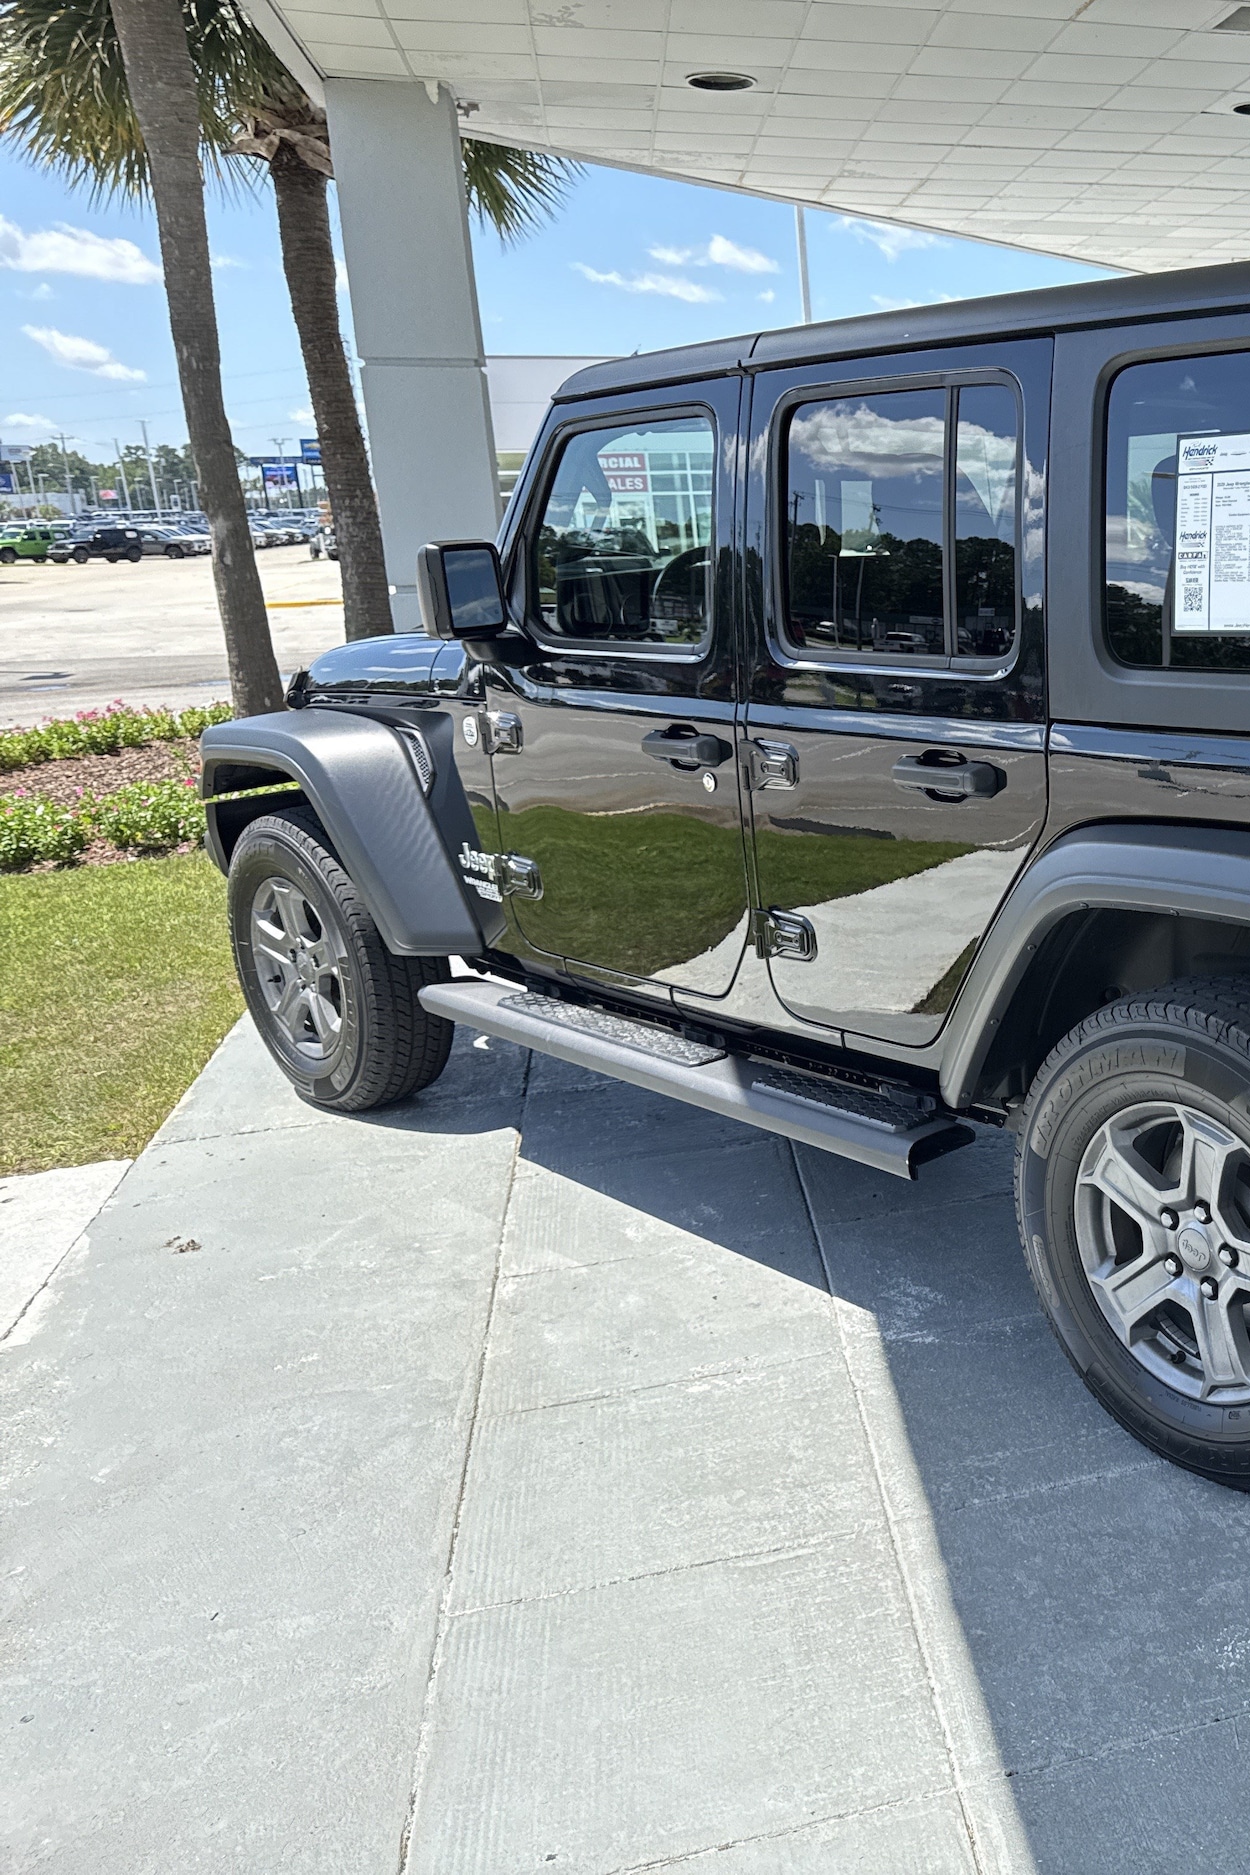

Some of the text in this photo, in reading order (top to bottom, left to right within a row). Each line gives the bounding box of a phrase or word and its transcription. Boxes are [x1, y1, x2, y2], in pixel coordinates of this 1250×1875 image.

[1182, 444, 1218, 460] Hendrick
[458, 842, 494, 881] Jeep
[1182, 1239, 1206, 1261] Jeep
